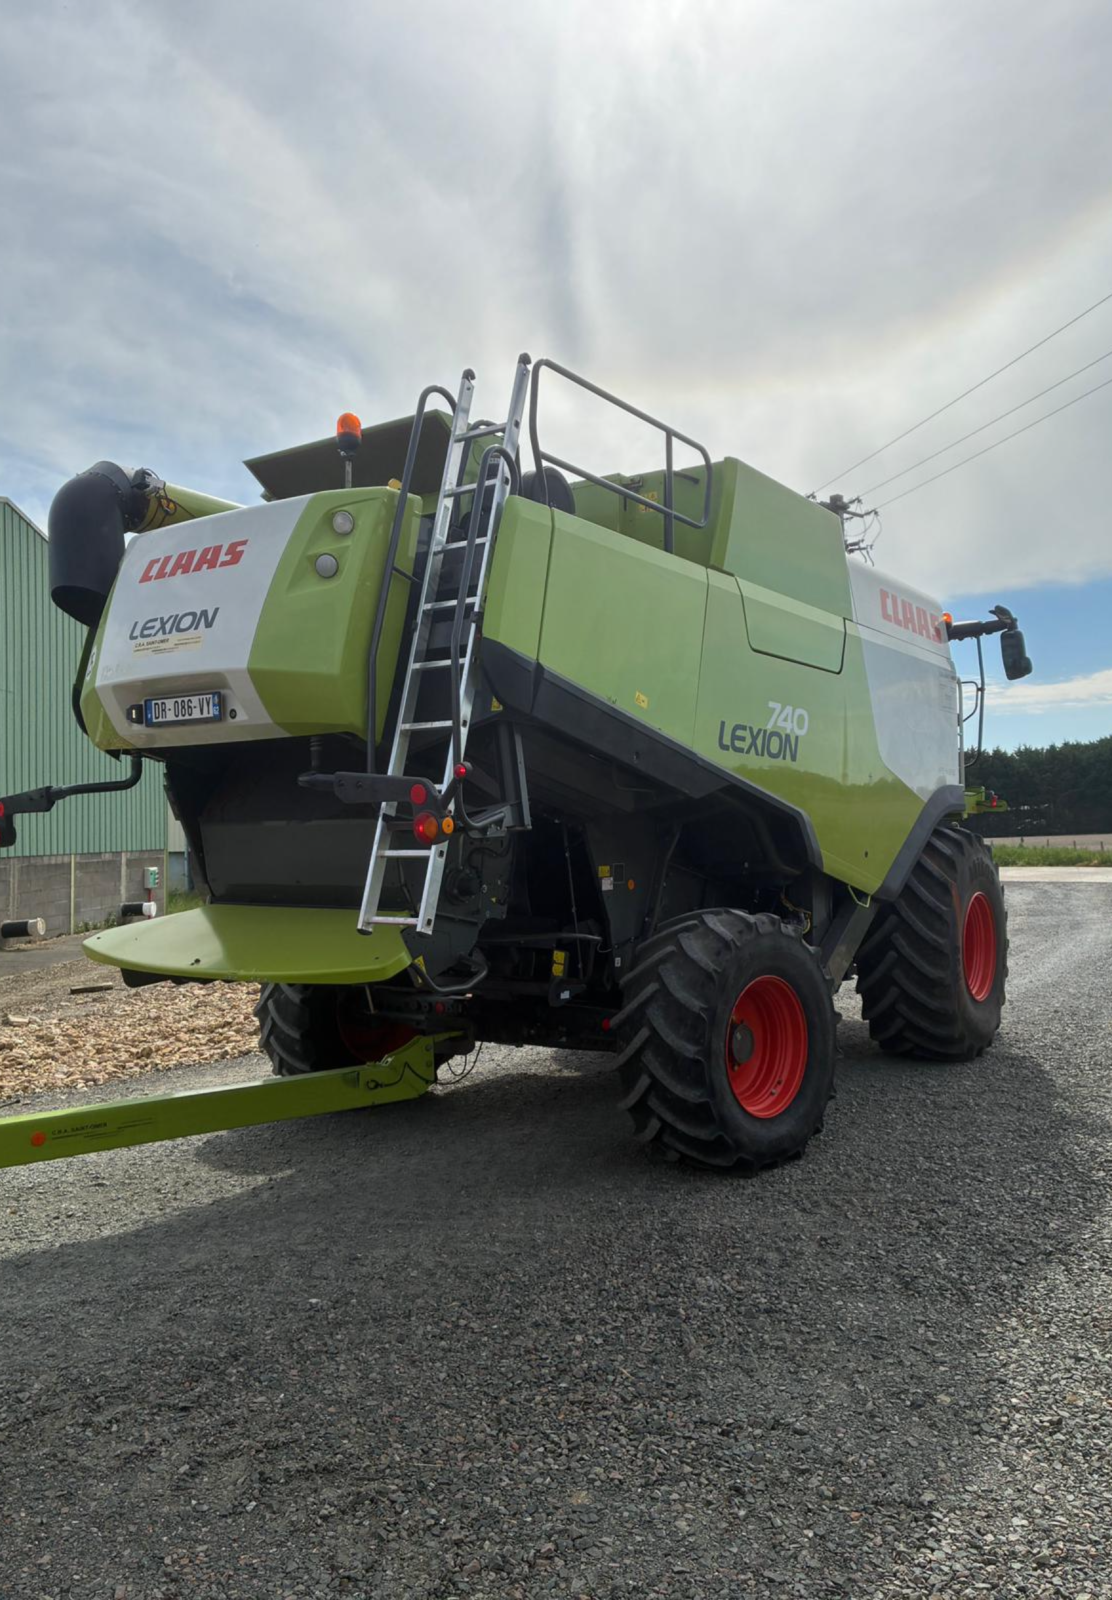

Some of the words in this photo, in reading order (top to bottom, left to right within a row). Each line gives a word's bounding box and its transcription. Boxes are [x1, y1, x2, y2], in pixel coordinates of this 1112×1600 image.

[139, 539, 249, 584] CLAAS
[129, 607, 220, 641] LEXION
[879, 588, 943, 645] CLAAS
[154, 696, 211, 720] DR-086-VY
[766, 701, 809, 736] 740
[718, 720, 799, 762] LEXION
